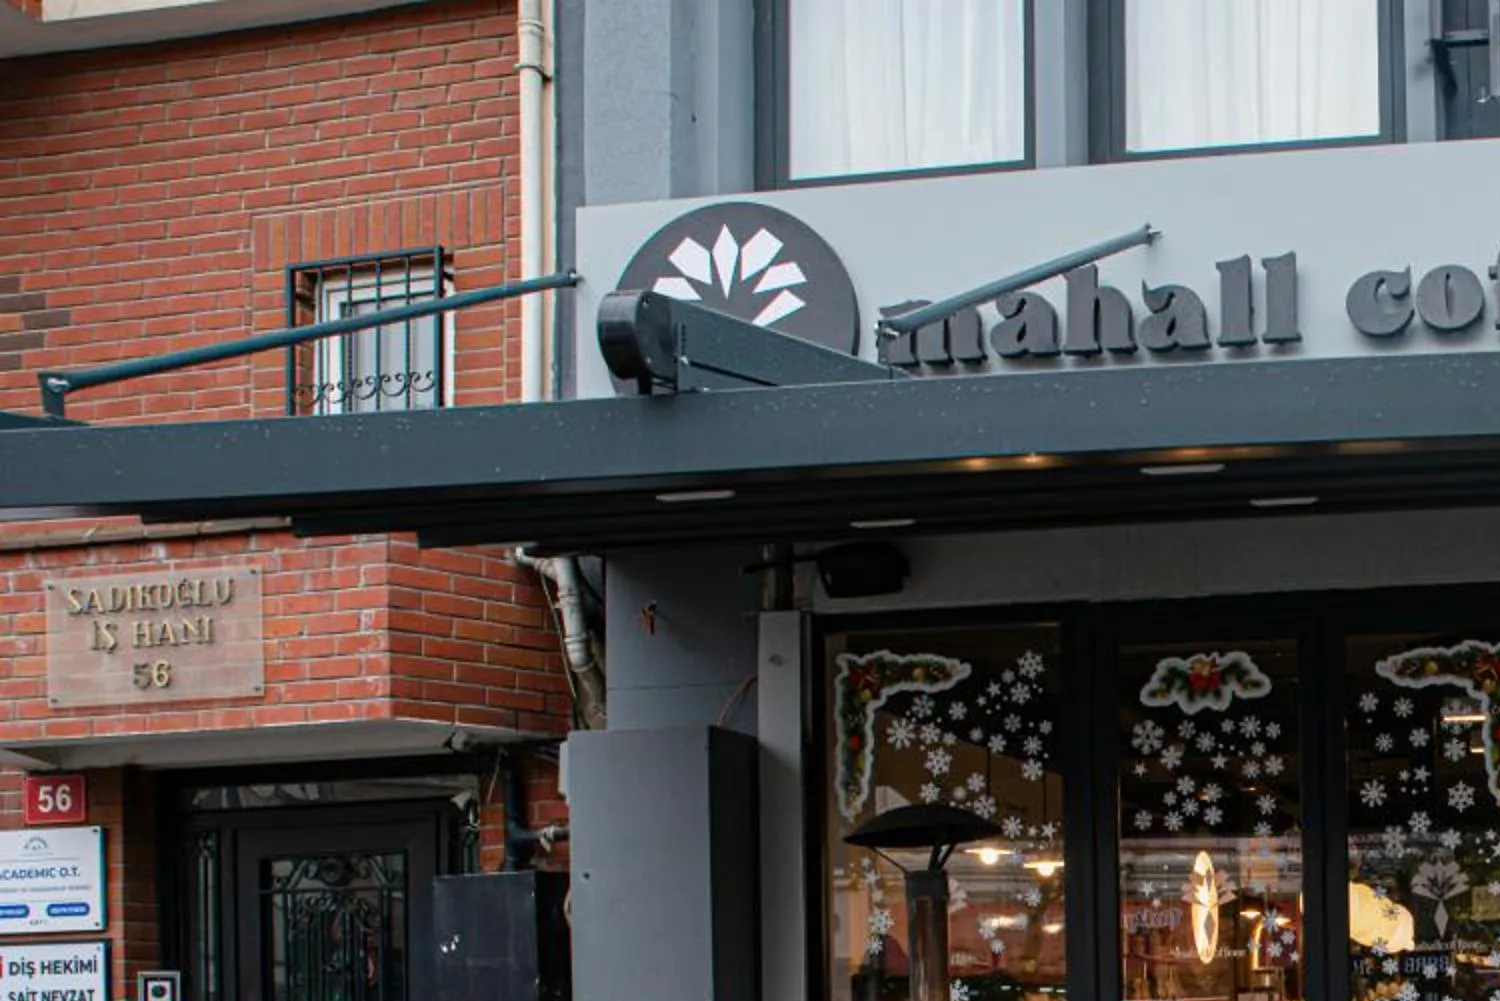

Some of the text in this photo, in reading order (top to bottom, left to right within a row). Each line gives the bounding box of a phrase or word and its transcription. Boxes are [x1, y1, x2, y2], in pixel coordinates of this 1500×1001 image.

[877, 251, 1302, 366] mahall
[132, 658, 172, 690] 56
[37, 784, 73, 813] 56
[0, 866, 56, 882] CADEMIC
[8, 956, 36, 979] DİŞ
[40, 954, 98, 976] HEKİMİ
